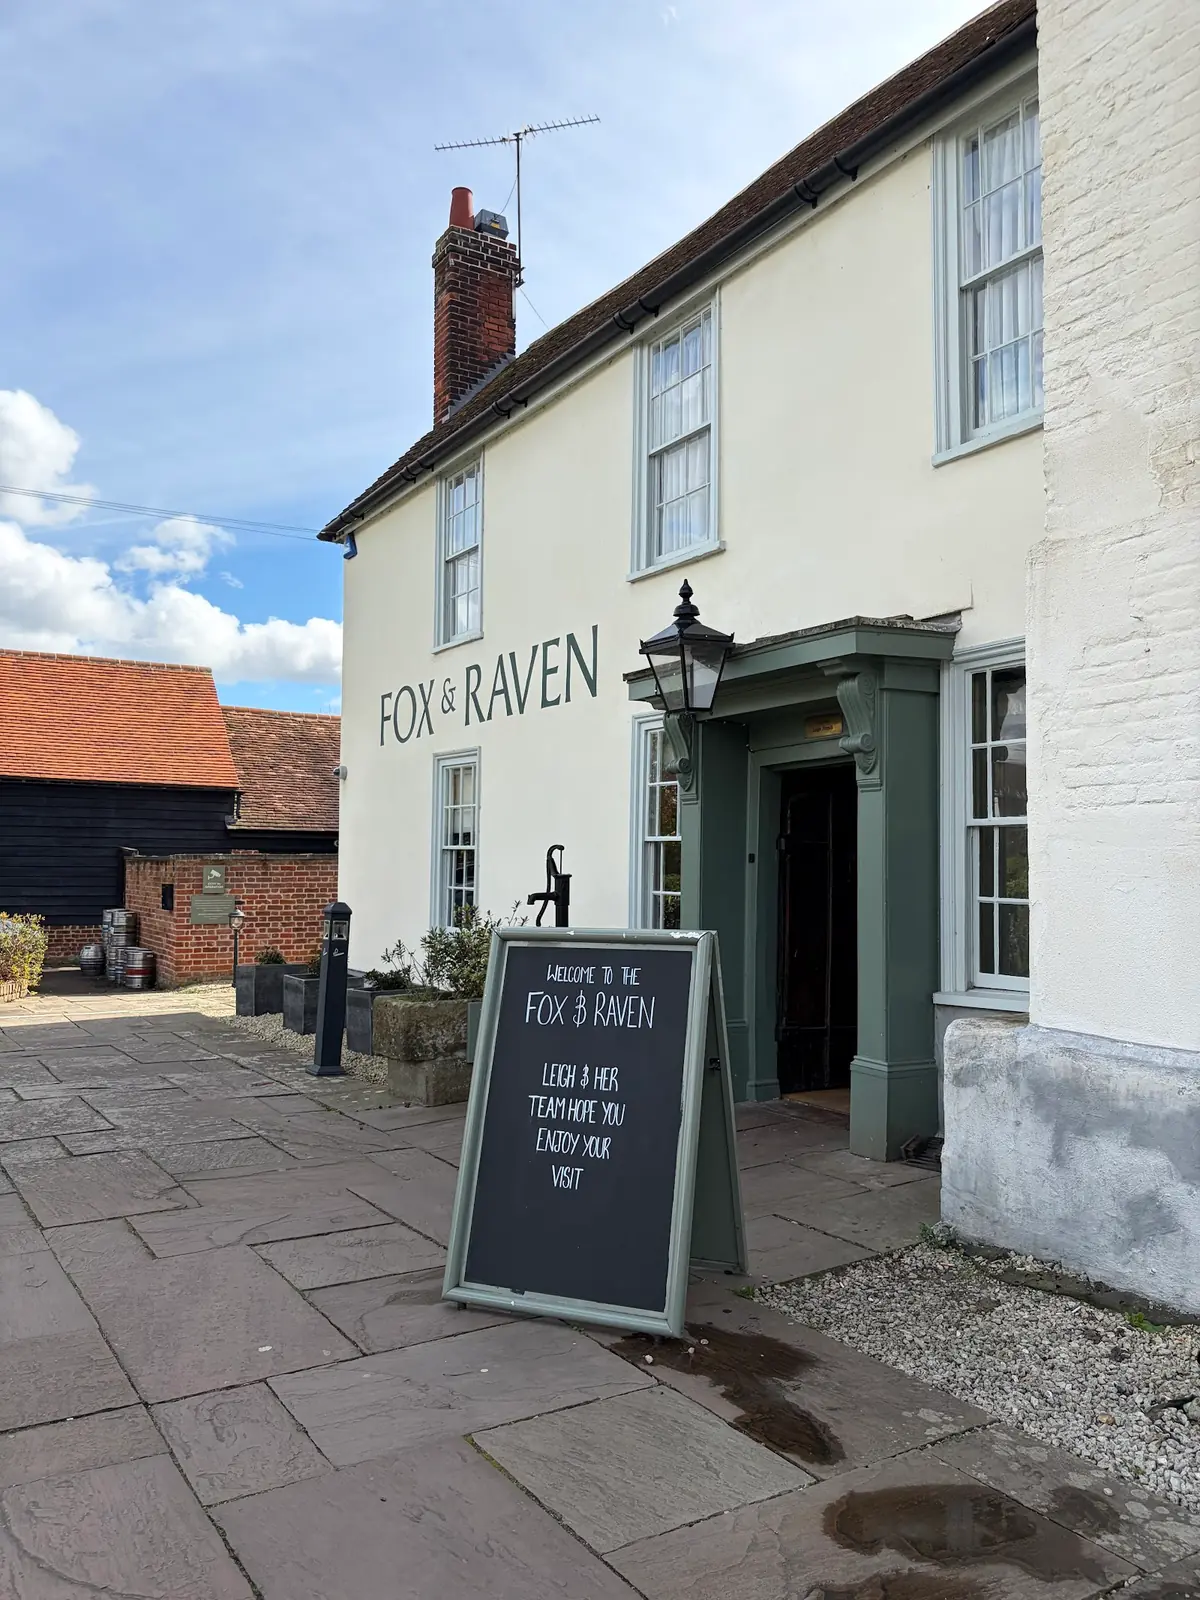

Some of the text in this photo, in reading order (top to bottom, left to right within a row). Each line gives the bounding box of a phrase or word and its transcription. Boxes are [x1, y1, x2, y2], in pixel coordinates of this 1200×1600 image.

[380, 624, 598, 746] FOX & RAVEN
[547, 965, 641, 985] WELCOME TO THE
[526, 990, 655, 1028] FOX & RAVEN
[542, 1063, 618, 1091] LEIGH & HER
[528, 1095, 625, 1126] TEAM HOPE YOU
[536, 1128, 611, 1159] ENJOY YOUR
[552, 1165, 584, 1190] VISIT
